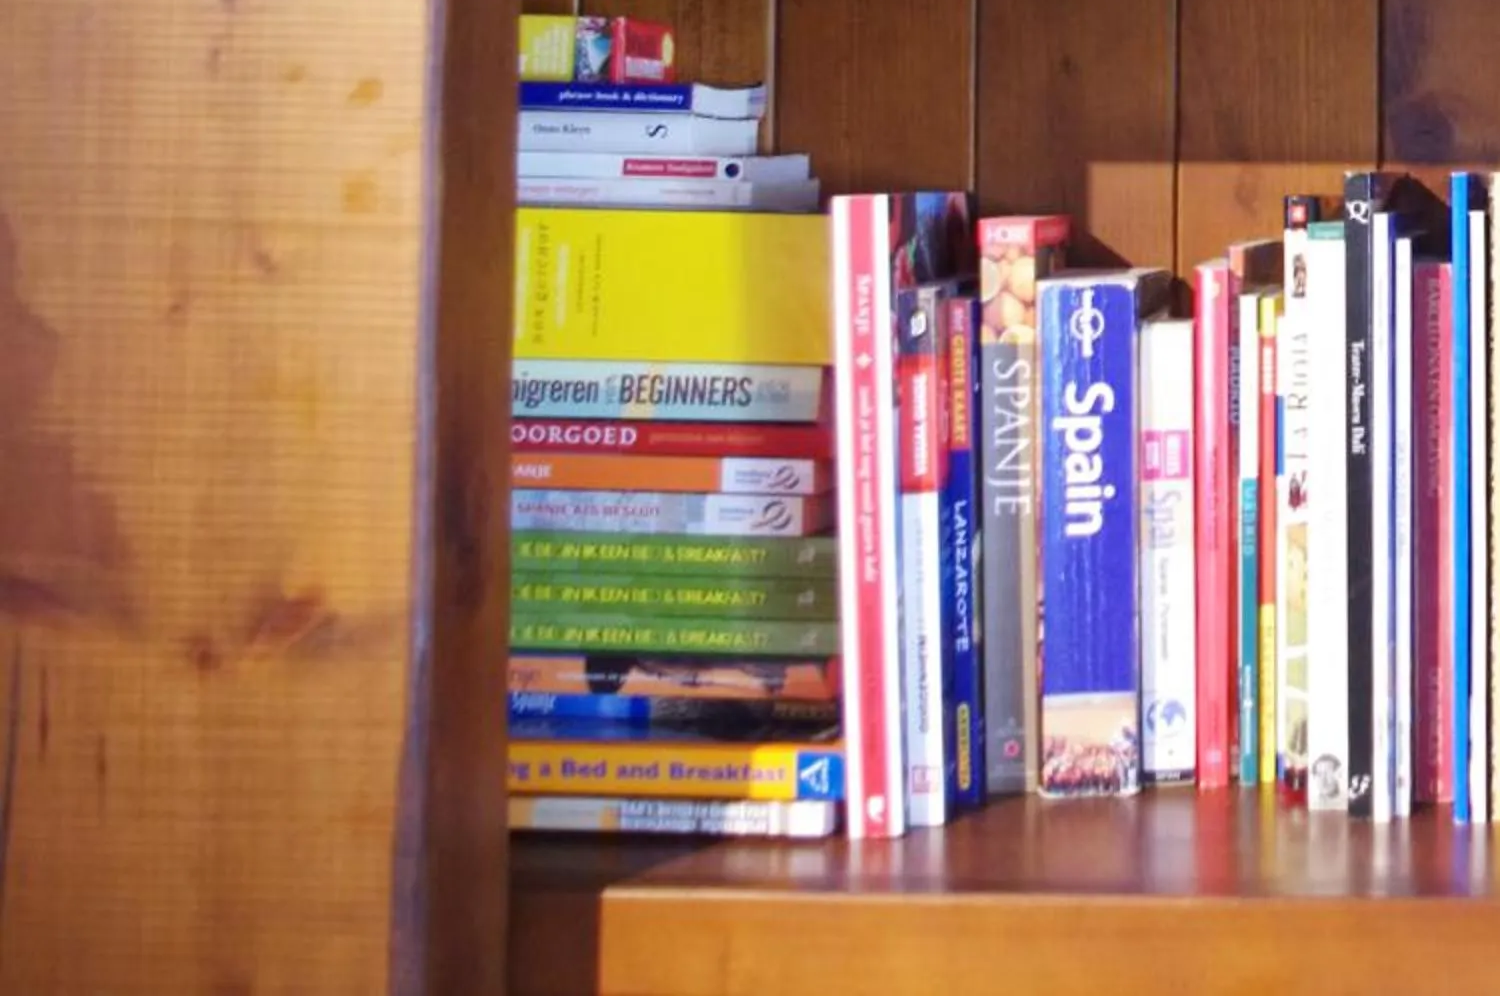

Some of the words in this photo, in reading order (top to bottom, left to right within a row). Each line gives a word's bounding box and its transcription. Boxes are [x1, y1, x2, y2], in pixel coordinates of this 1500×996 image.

[618, 373, 754, 408] BEGINNERS
[986, 357, 1031, 516] SPANJE
[1051, 380, 1116, 537] Spain
[952, 499, 970, 652] LANZAROTE
[560, 759, 608, 780] Bed
[616, 761, 660, 781] and
[668, 760, 786, 783] Breakfast
